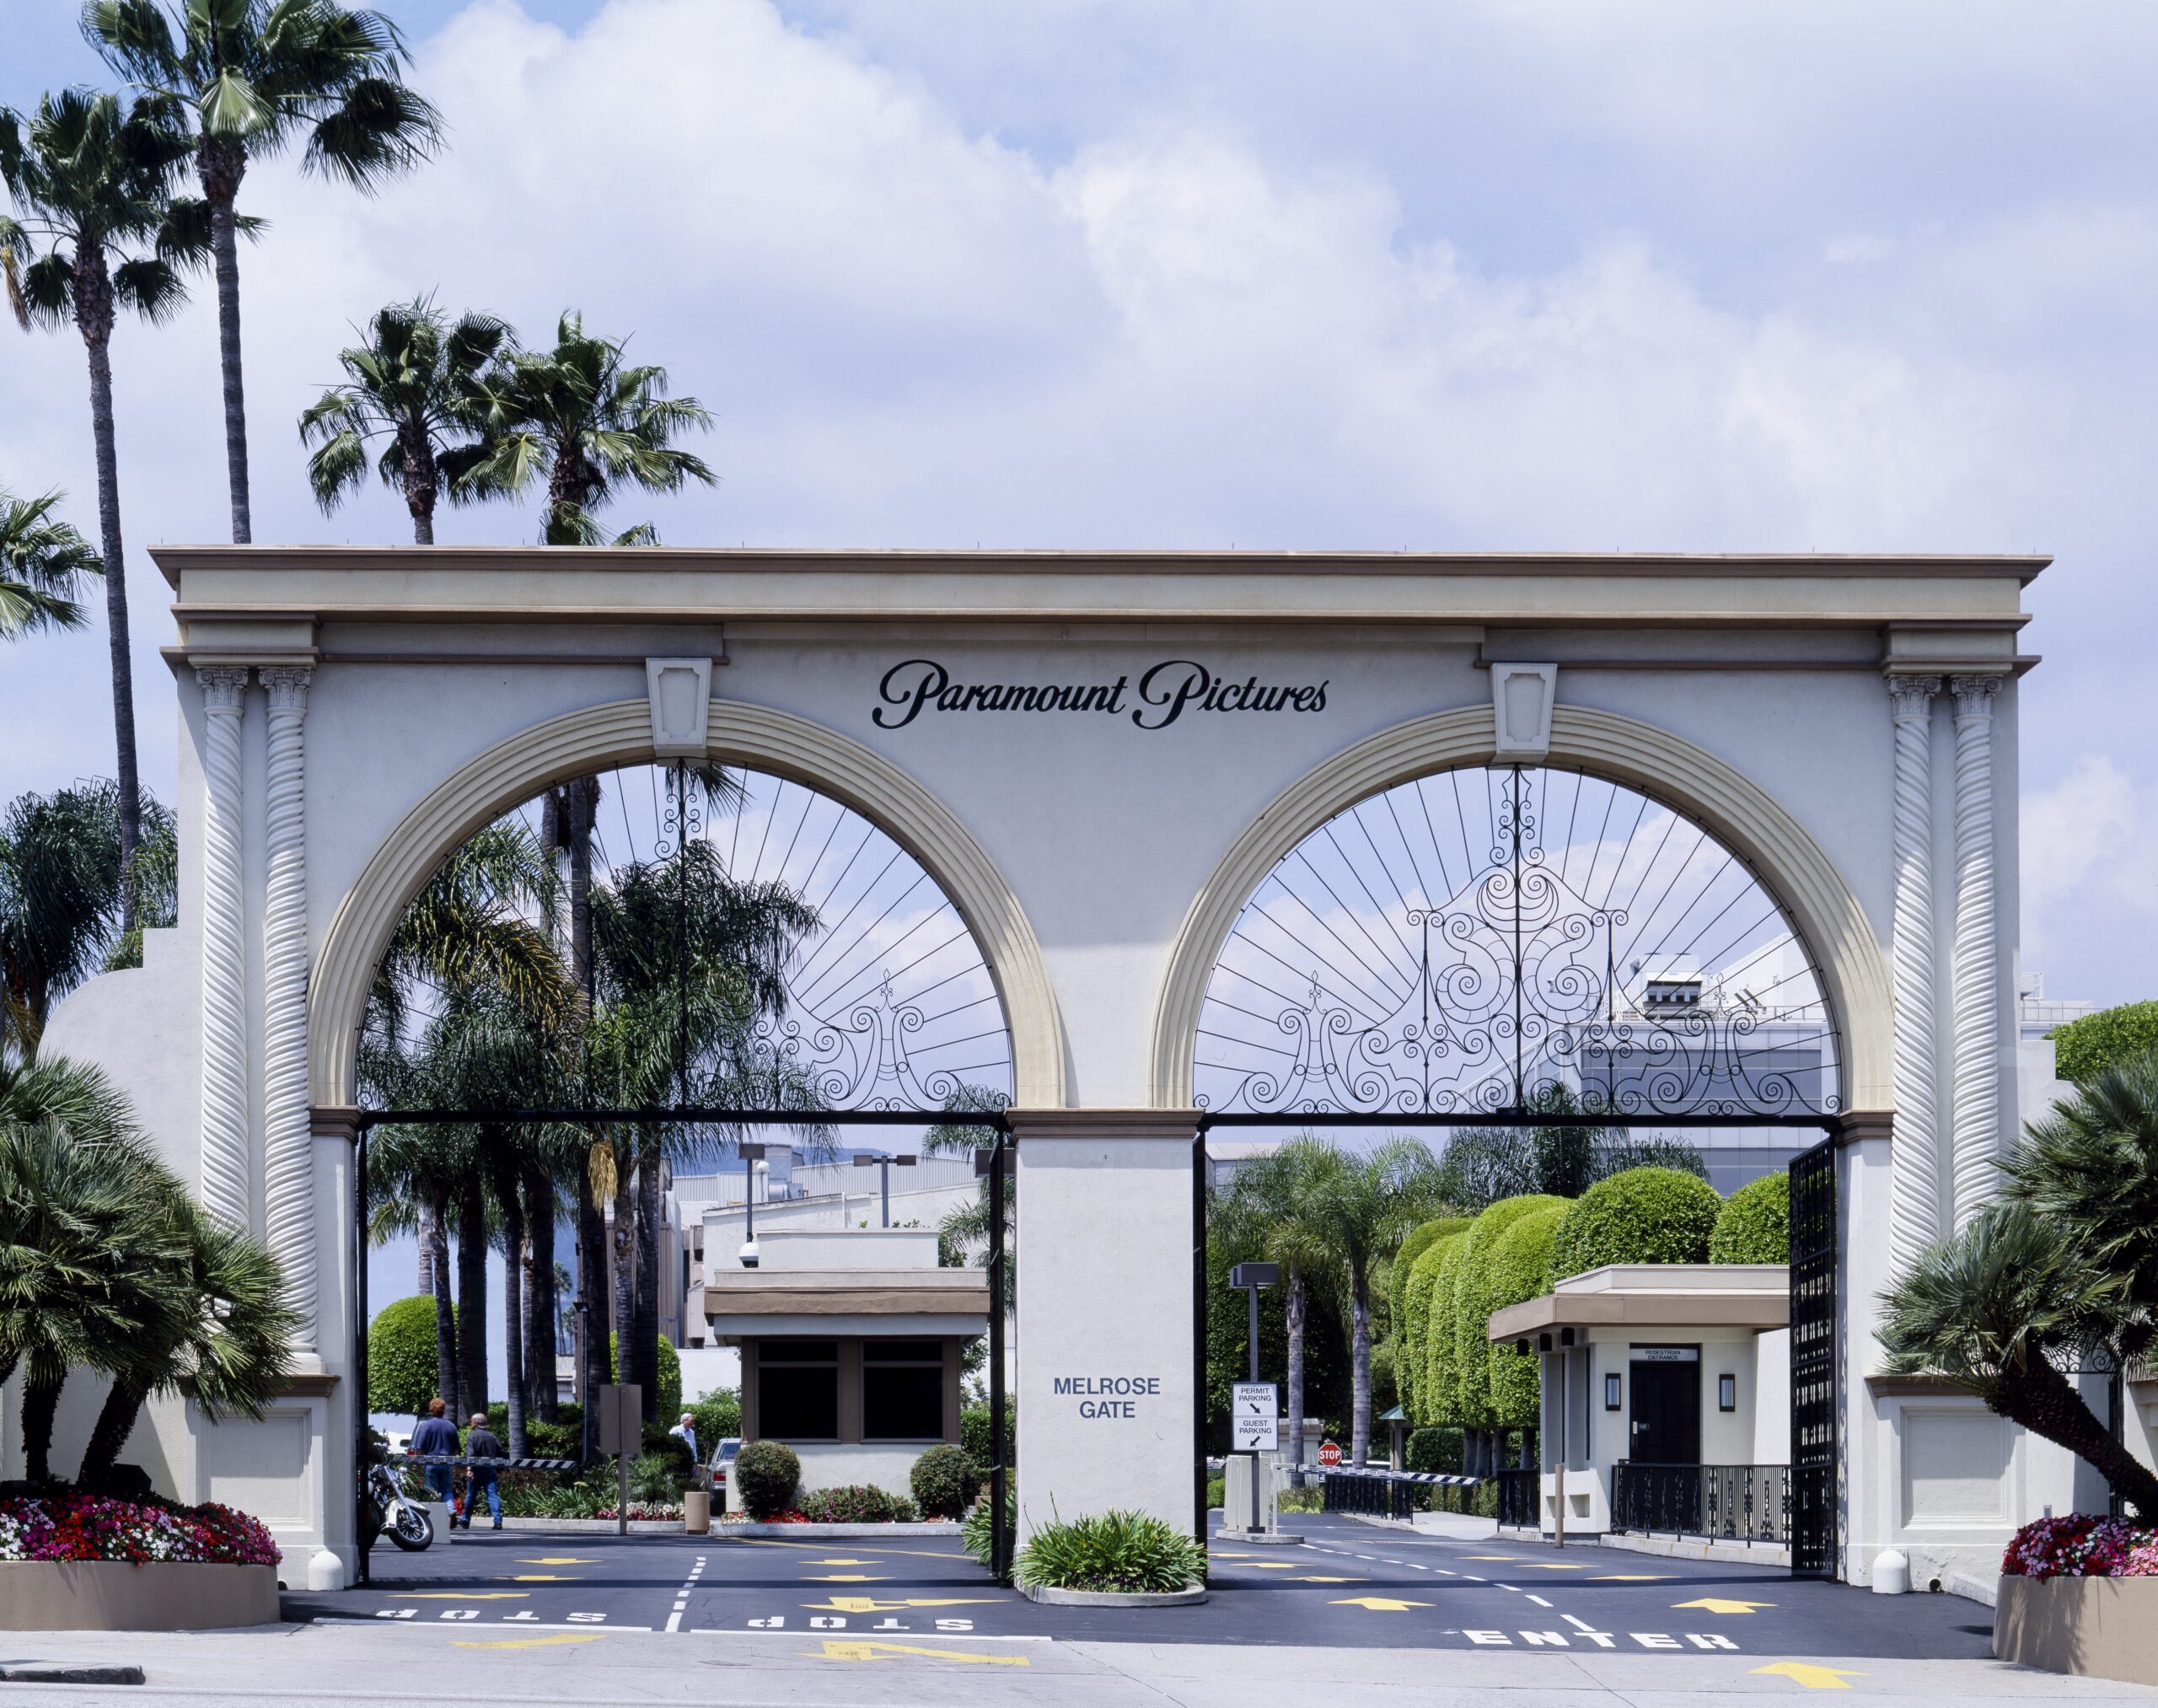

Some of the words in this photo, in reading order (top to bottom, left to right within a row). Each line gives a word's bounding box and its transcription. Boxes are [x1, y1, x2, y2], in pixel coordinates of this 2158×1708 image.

[872, 659, 1128, 730] Paramount
[1131, 660, 1329, 730] Pictures
[1054, 1378, 1161, 1395] MELROSE
[1079, 1400, 1135, 1419] GATE
[1319, 1450, 1340, 1460] STOP
[375, 1609, 608, 1622] STOP
[747, 1615, 974, 1631] STOP
[1462, 1630, 1740, 1650] ENTER
